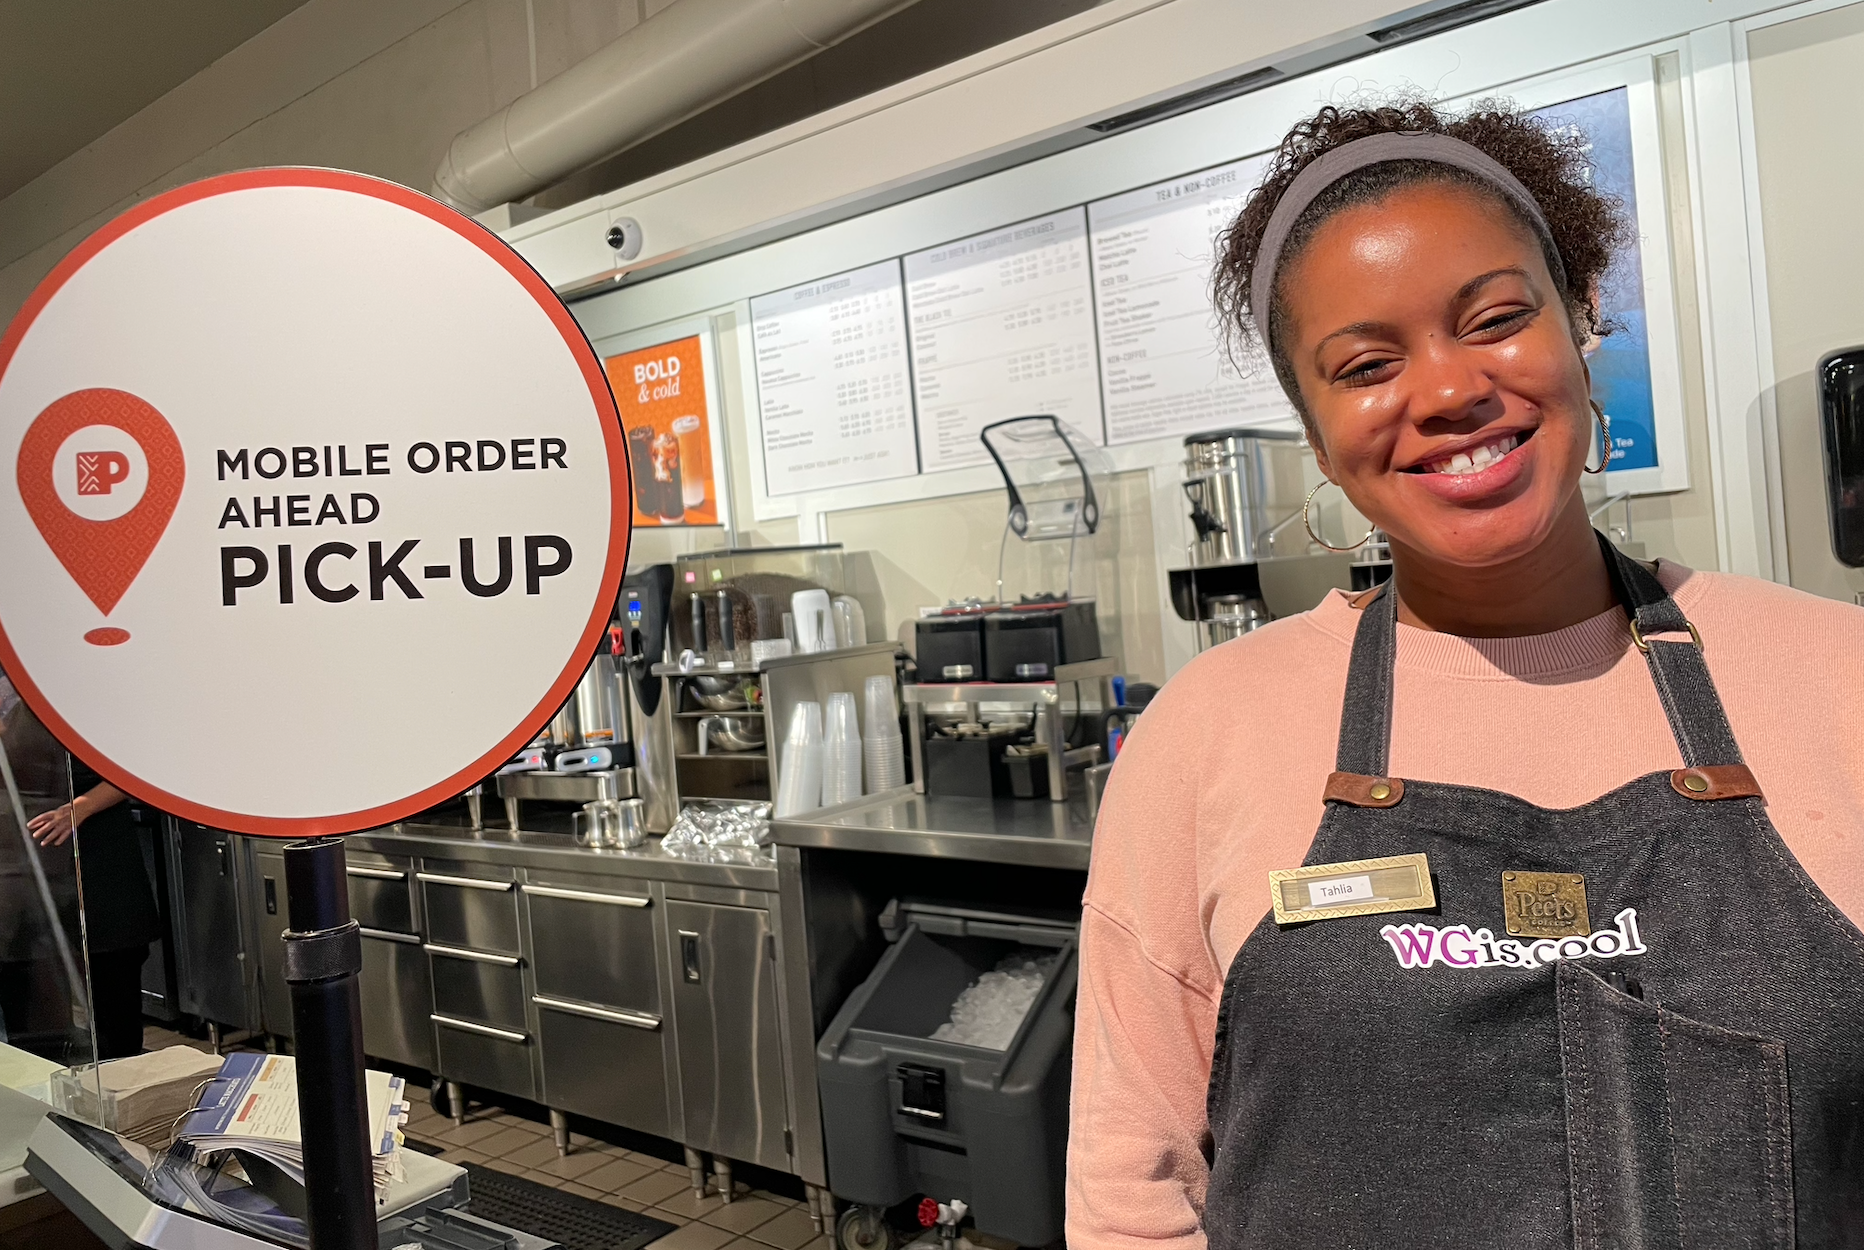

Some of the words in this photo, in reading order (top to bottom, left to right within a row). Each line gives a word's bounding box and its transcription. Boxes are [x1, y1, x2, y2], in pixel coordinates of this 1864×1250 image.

[1156, 189, 1171, 201] TEA
[1184, 170, 1236, 194] NON-COFFEE
[1014, 221, 1055, 241] BEVERAGES
[822, 277, 851, 294] ESPRESSO
[634, 356, 681, 384] BOLD
[1107, 349, 1147, 364] NON-COFFEE
[637, 383, 650, 404] &
[653, 376, 681, 401] cold
[1615, 437, 1634, 448] Tea
[217, 443, 390, 481] MOBILE
[407, 438, 568, 473] ORDER
[218, 493, 380, 529] AHEAD
[221, 535, 573, 606] PICK-UP
[1320, 884, 1353, 897] Tahlia
